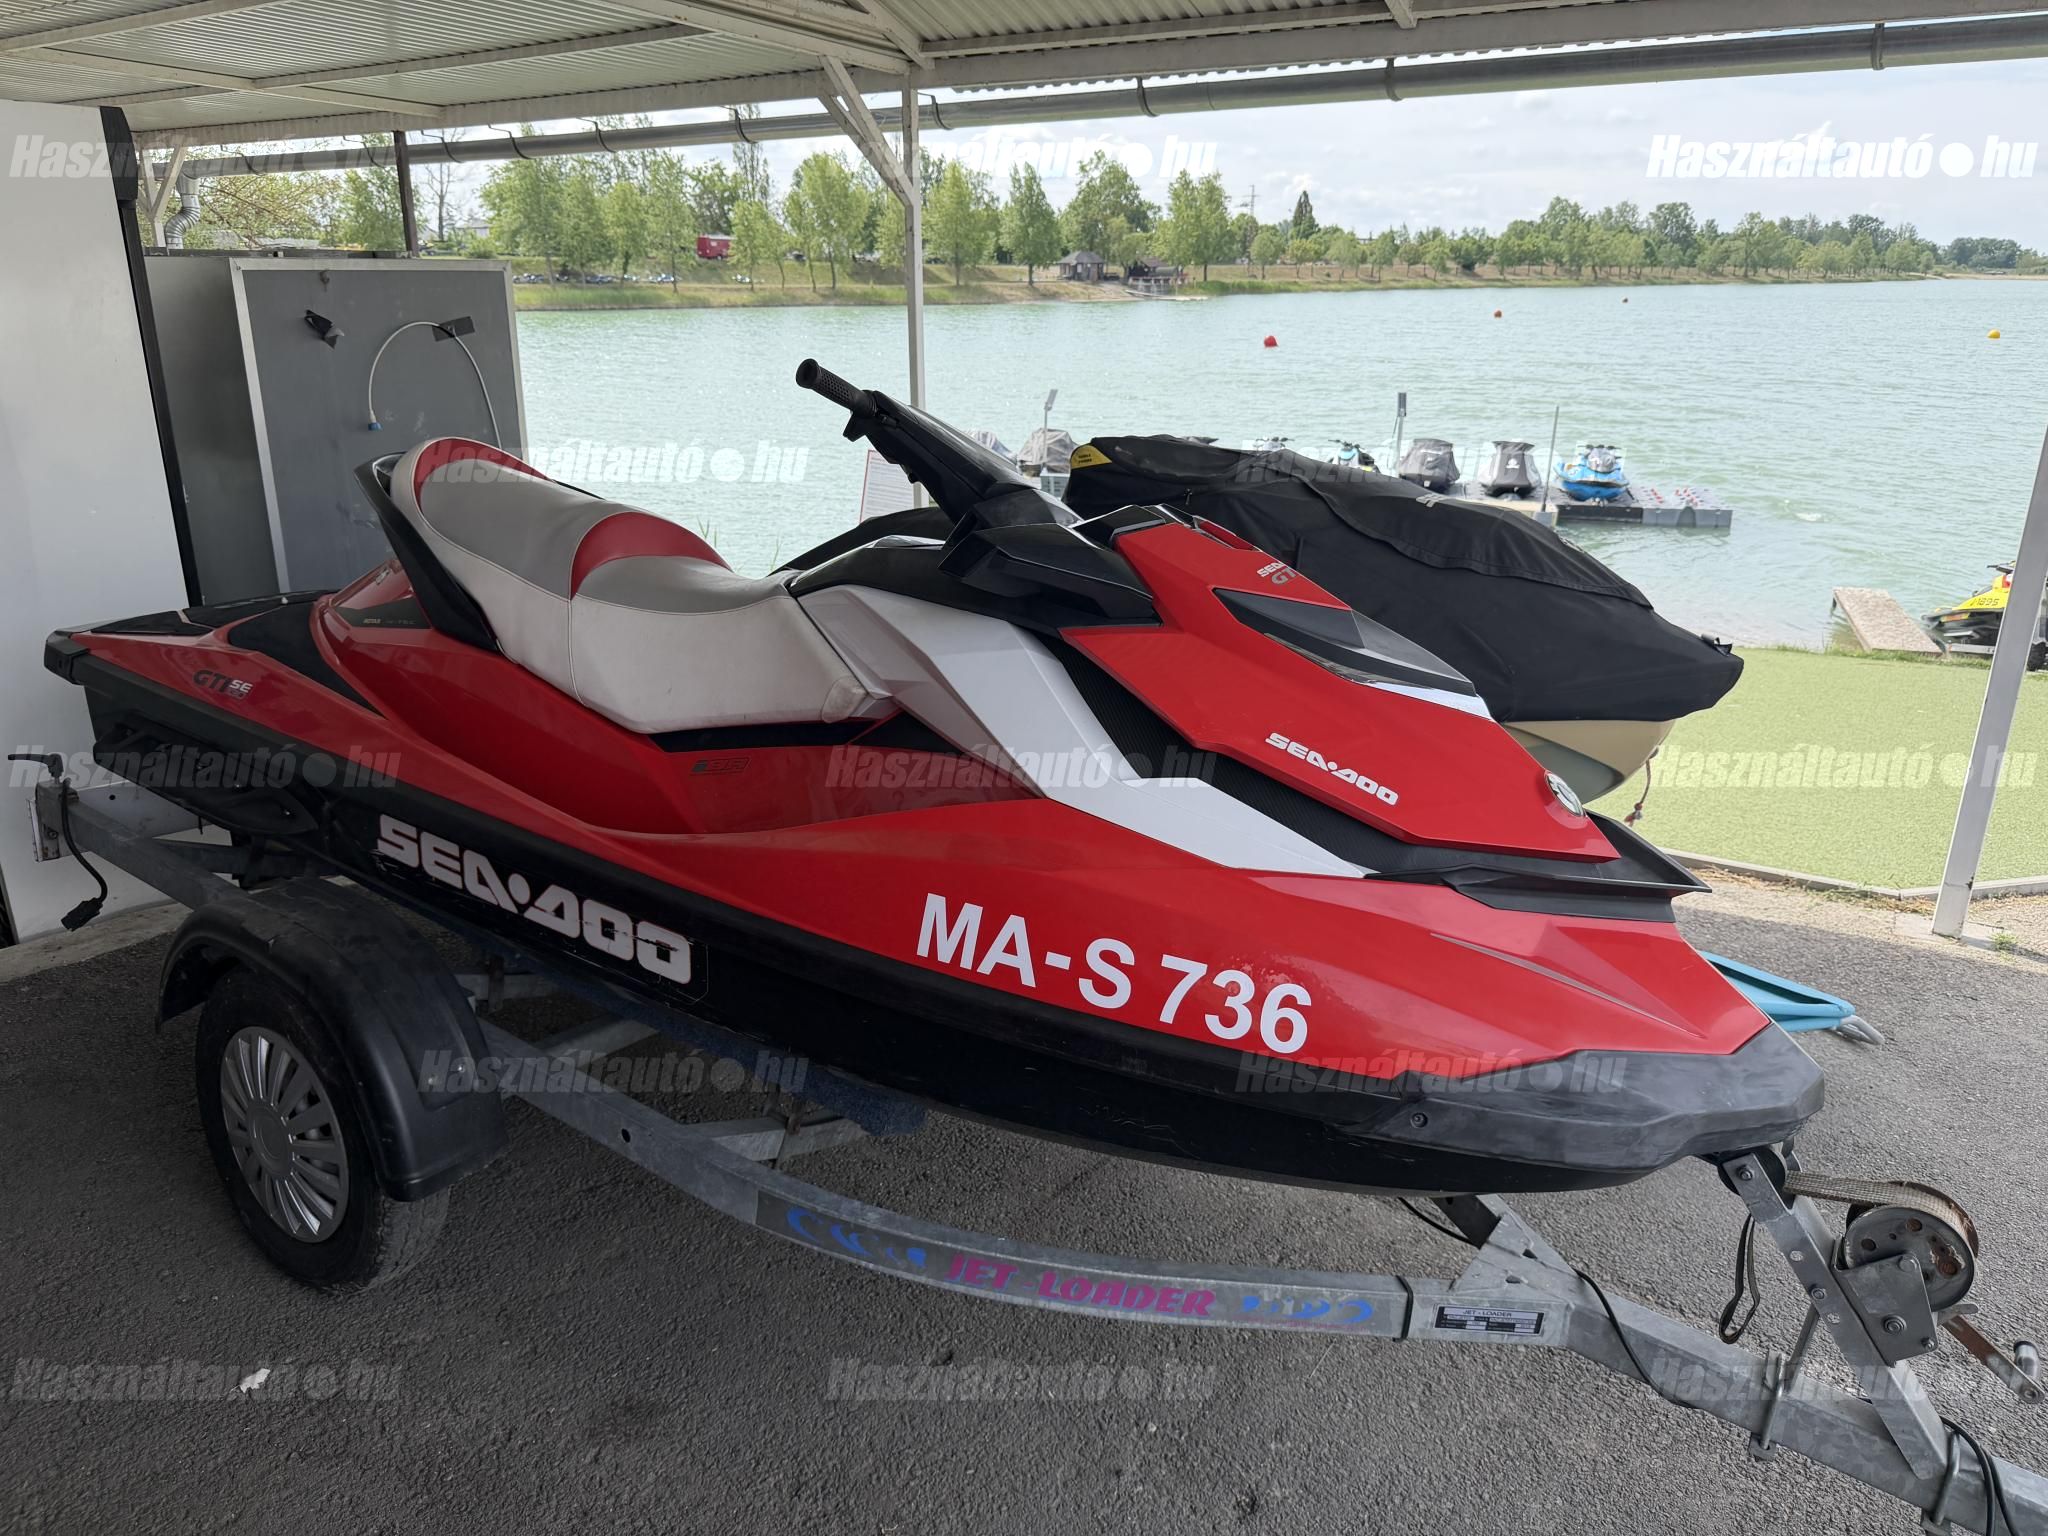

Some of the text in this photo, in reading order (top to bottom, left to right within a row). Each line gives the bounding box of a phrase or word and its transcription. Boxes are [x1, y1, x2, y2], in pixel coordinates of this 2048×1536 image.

[229, 679, 254, 693] SE
[916, 893, 1312, 1054] MA-S 736
[944, 1254, 1018, 1291] JET
[1038, 1271, 1216, 1317] LOADER
[1482, 1310, 1512, 1318] LOADER
